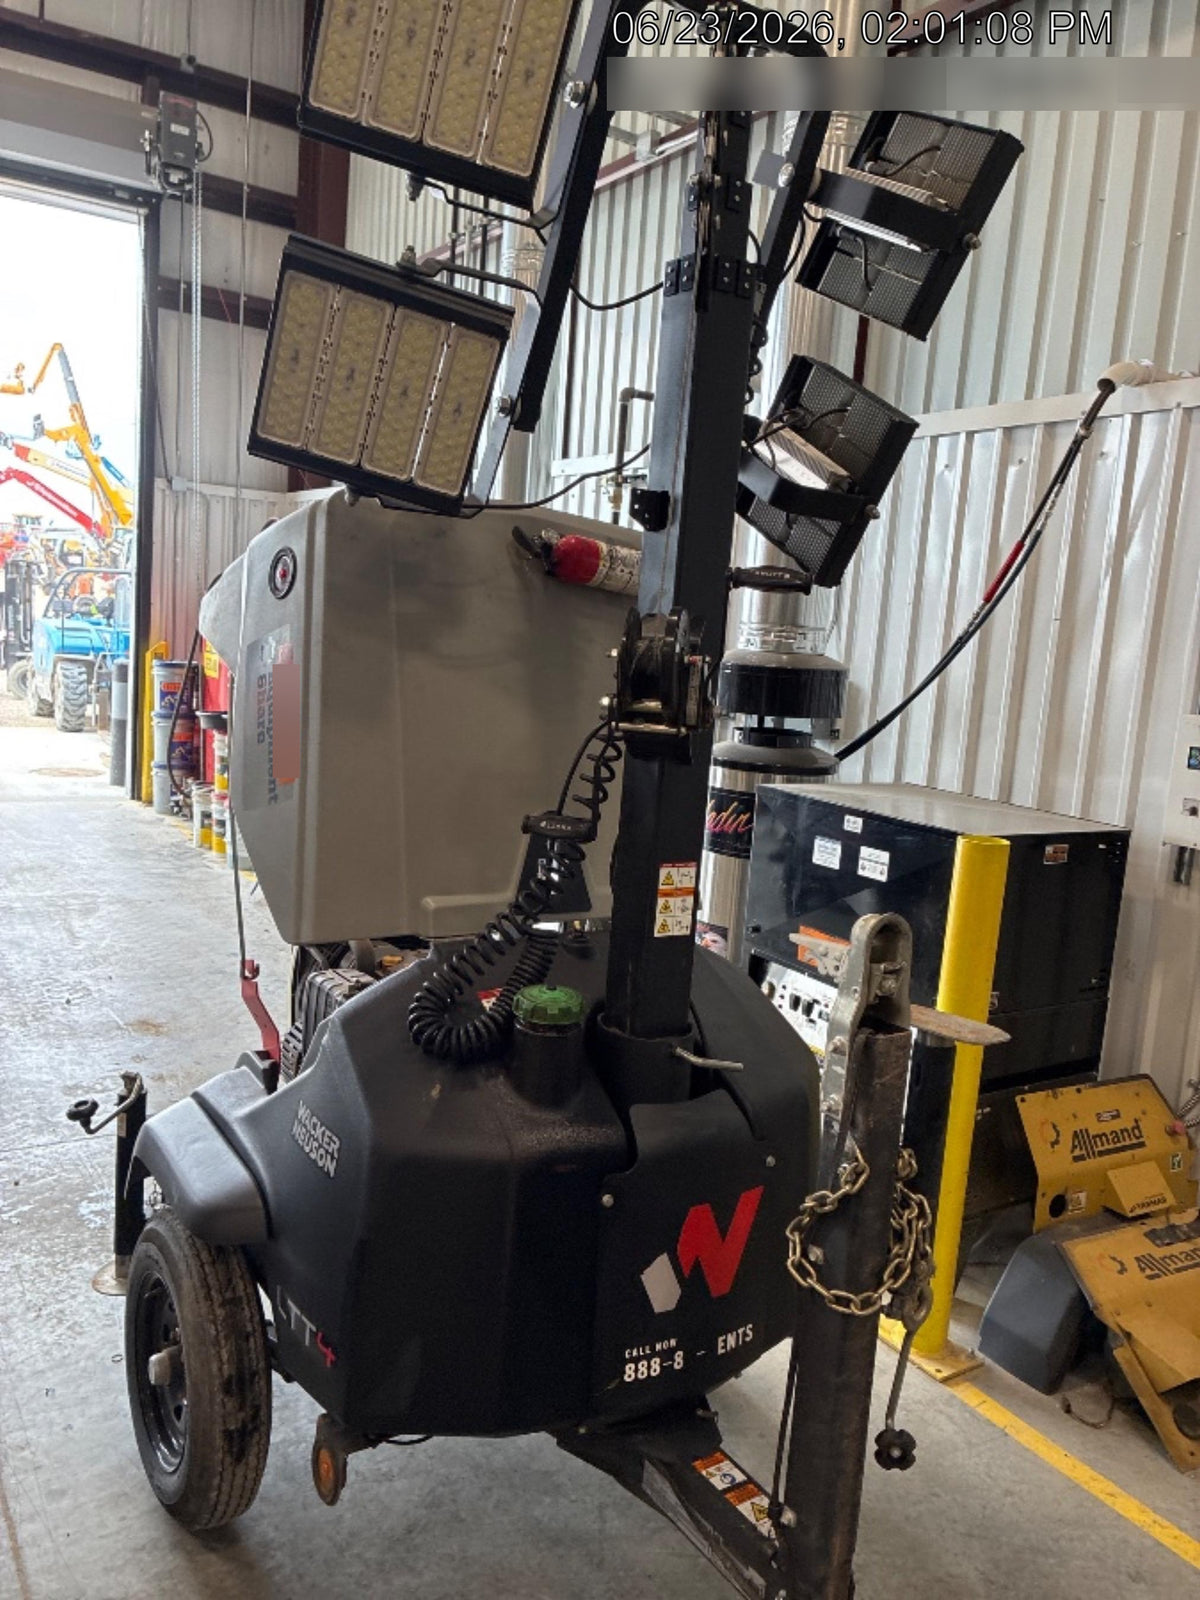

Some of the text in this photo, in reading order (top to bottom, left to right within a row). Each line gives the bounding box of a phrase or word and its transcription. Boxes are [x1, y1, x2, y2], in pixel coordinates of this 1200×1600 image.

[291, 1118, 337, 1178] NEUSON
[298, 1099, 340, 1160] WACKER
[1070, 1117, 1144, 1160] Allmand
[276, 1284, 337, 1367] LTT4
[625, 1345, 651, 1359] CALL
